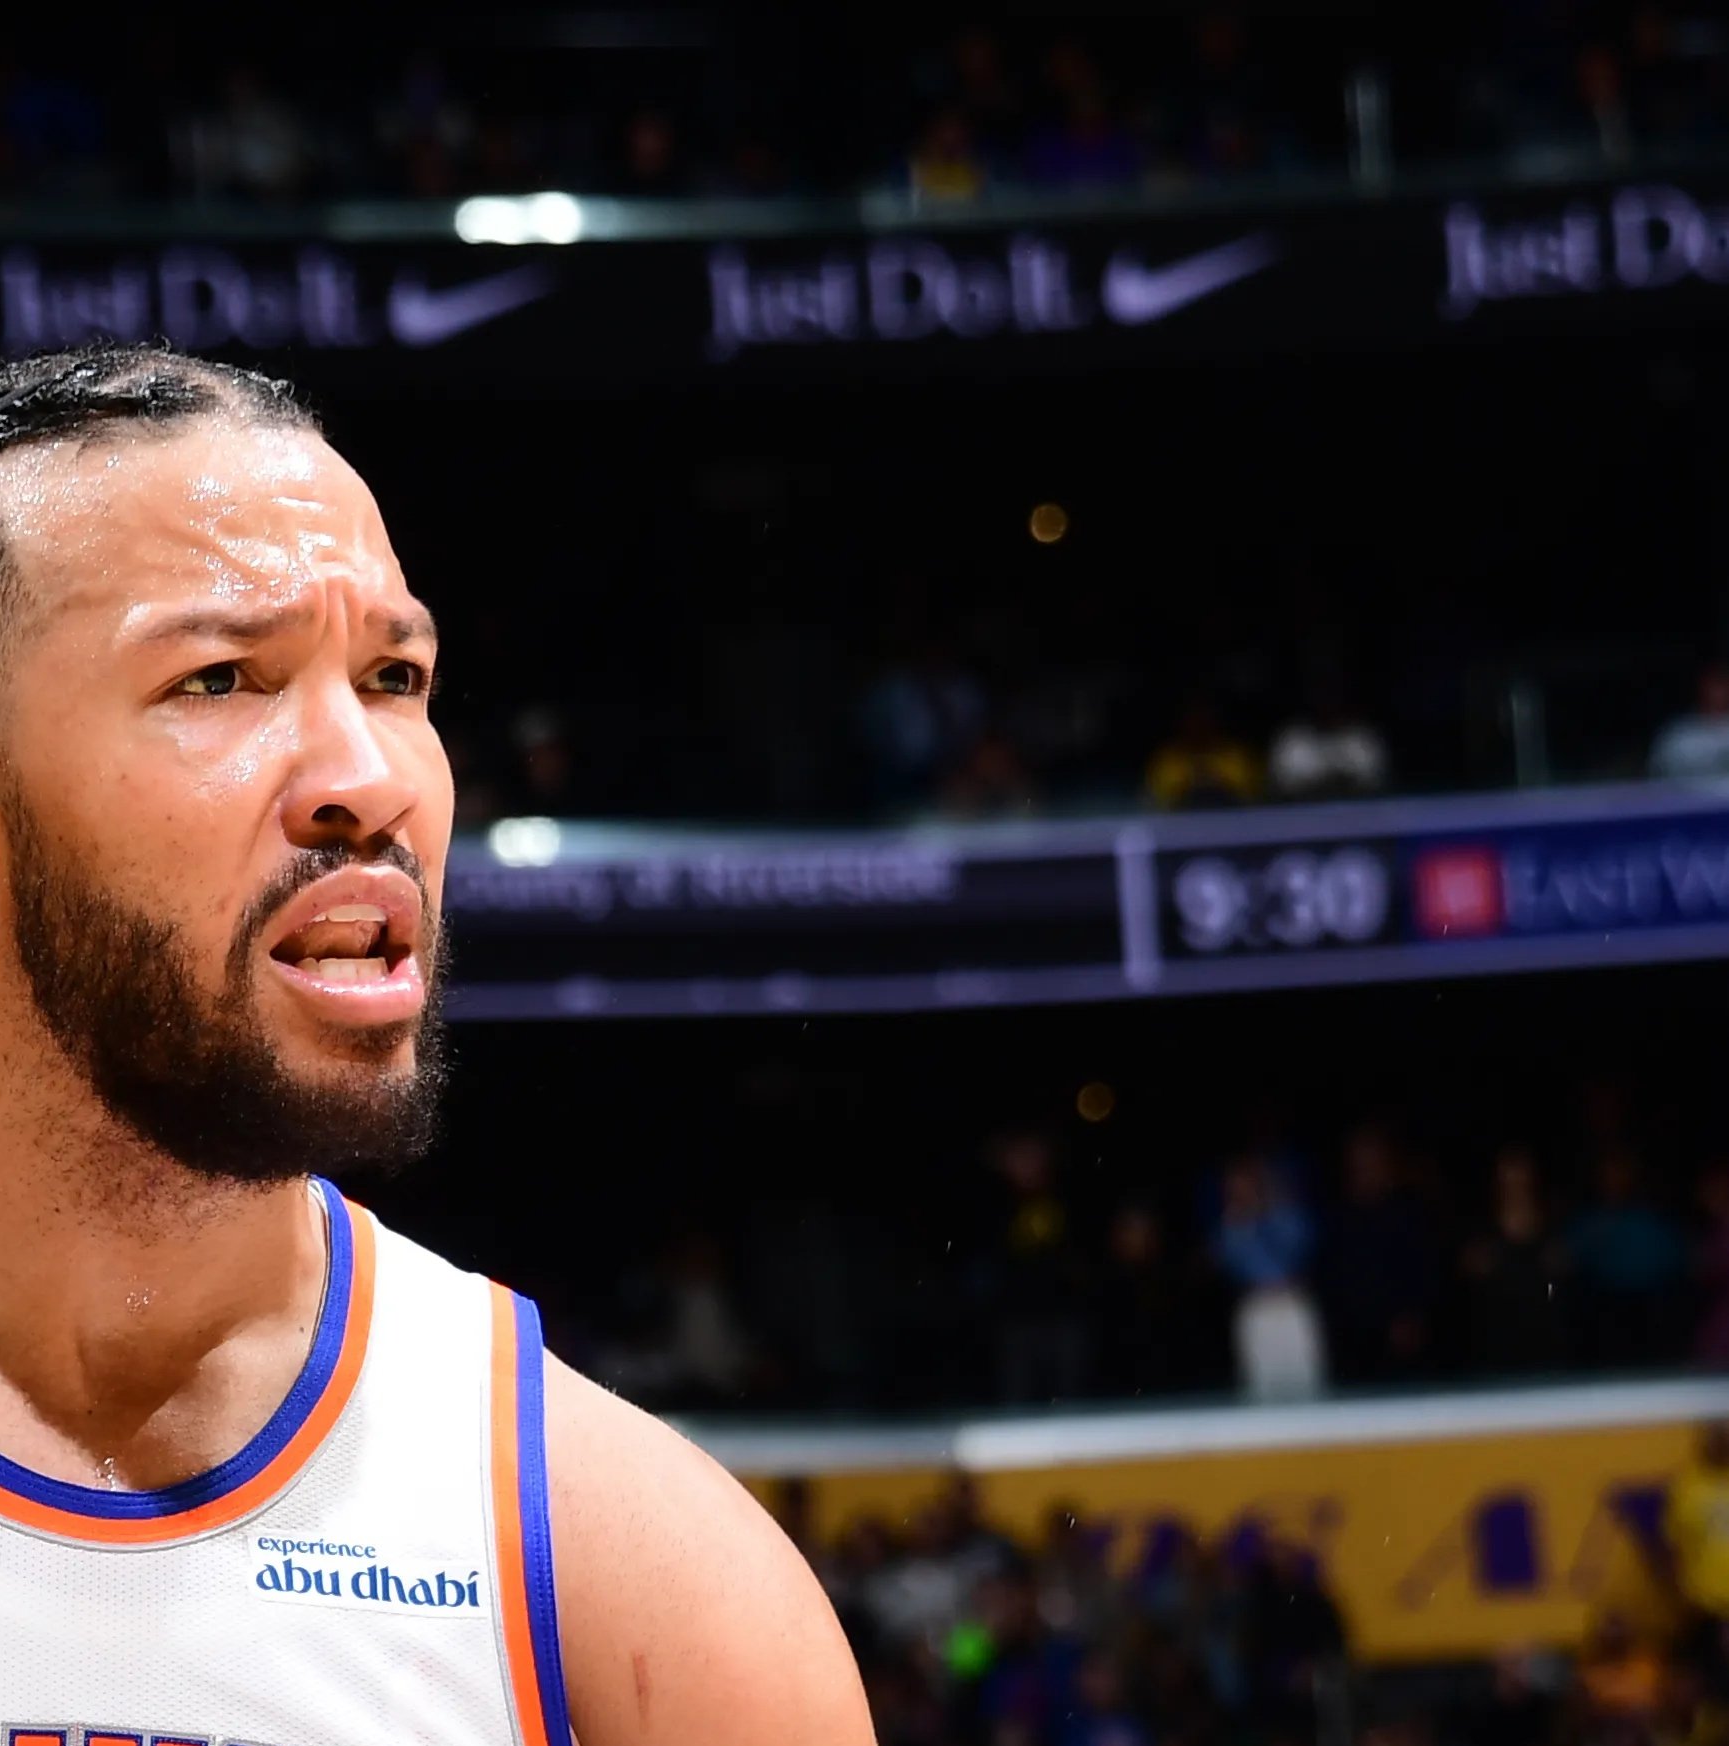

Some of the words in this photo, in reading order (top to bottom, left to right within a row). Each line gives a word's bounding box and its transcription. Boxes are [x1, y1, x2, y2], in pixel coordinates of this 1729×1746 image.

[1175, 851, 1386, 950] 9:30
[257, 1536, 377, 1559] experience
[255, 1558, 342, 1597] abu
